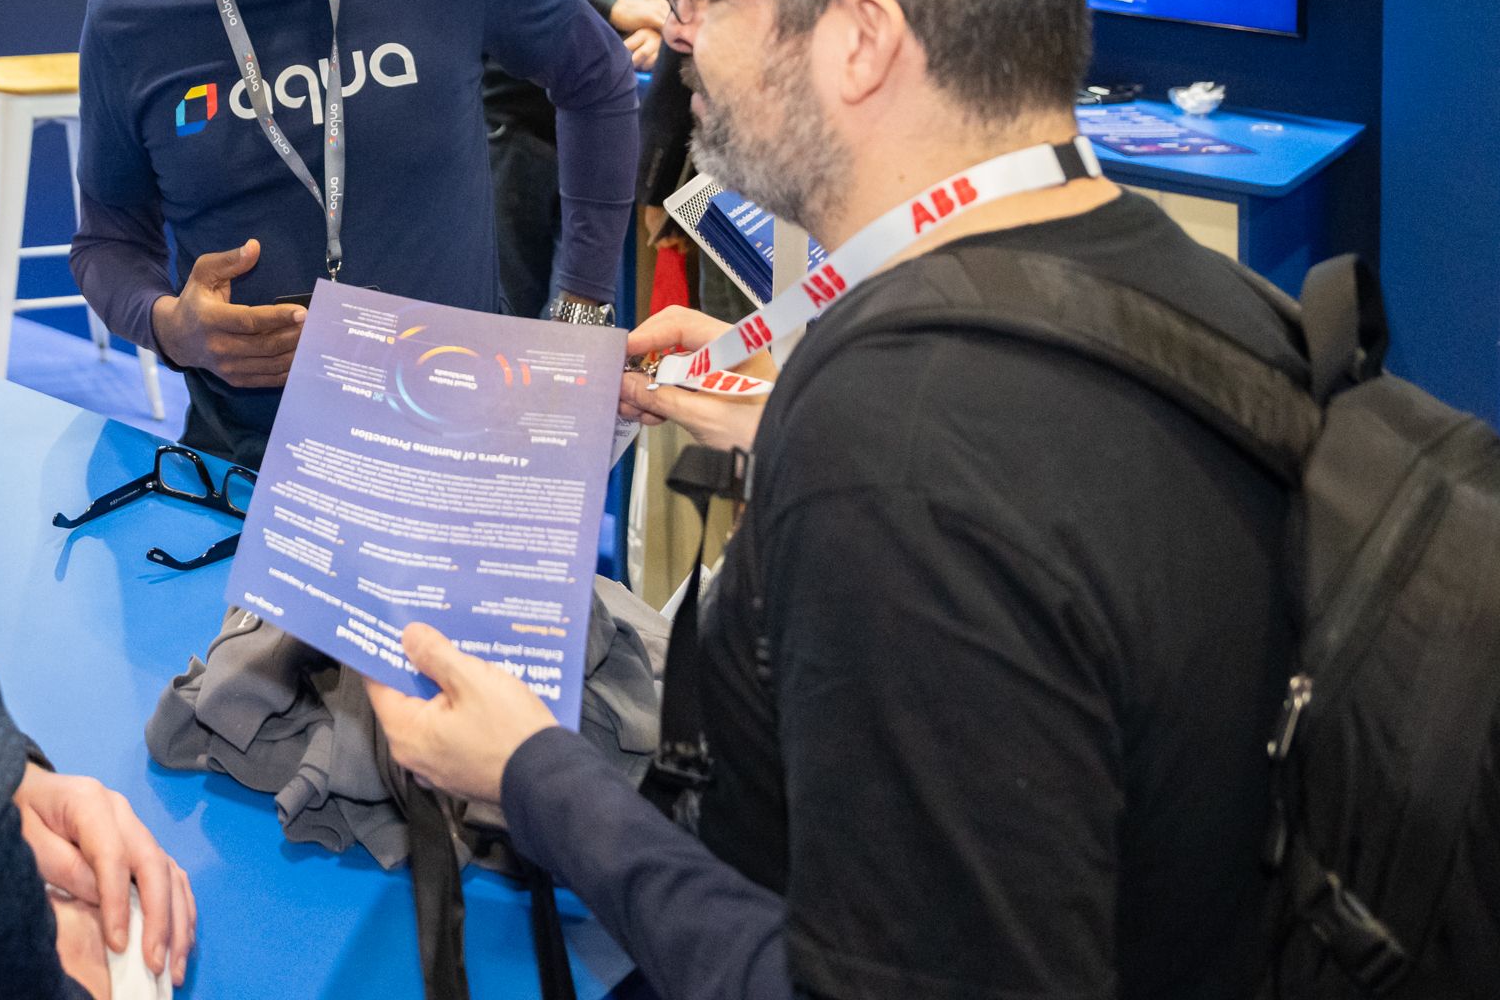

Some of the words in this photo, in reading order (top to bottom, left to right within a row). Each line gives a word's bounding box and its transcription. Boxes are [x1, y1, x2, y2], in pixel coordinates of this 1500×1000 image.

[229, 42, 418, 125] aqua
[245, 60, 260, 93] aqua
[330, 103, 342, 137] aqua
[268, 124, 290, 155] aqua
[330, 176, 342, 211] aqua
[910, 177, 978, 234] ABB
[802, 263, 847, 309] ABB
[738, 314, 773, 354] ABB
[686, 347, 712, 380] ABB
[701, 370, 762, 392] ABB
[350, 427, 412, 451] Protection
[413, 442, 462, 459] Runtime
[463, 451, 477, 463] of
[478, 452, 518, 466] Layers
[519, 457, 529, 468] 4
[336, 625, 378, 656] Cloud
[492, 641, 523, 656] policy
[523, 647, 564, 663] Enforce
[527, 664, 562, 681] with
